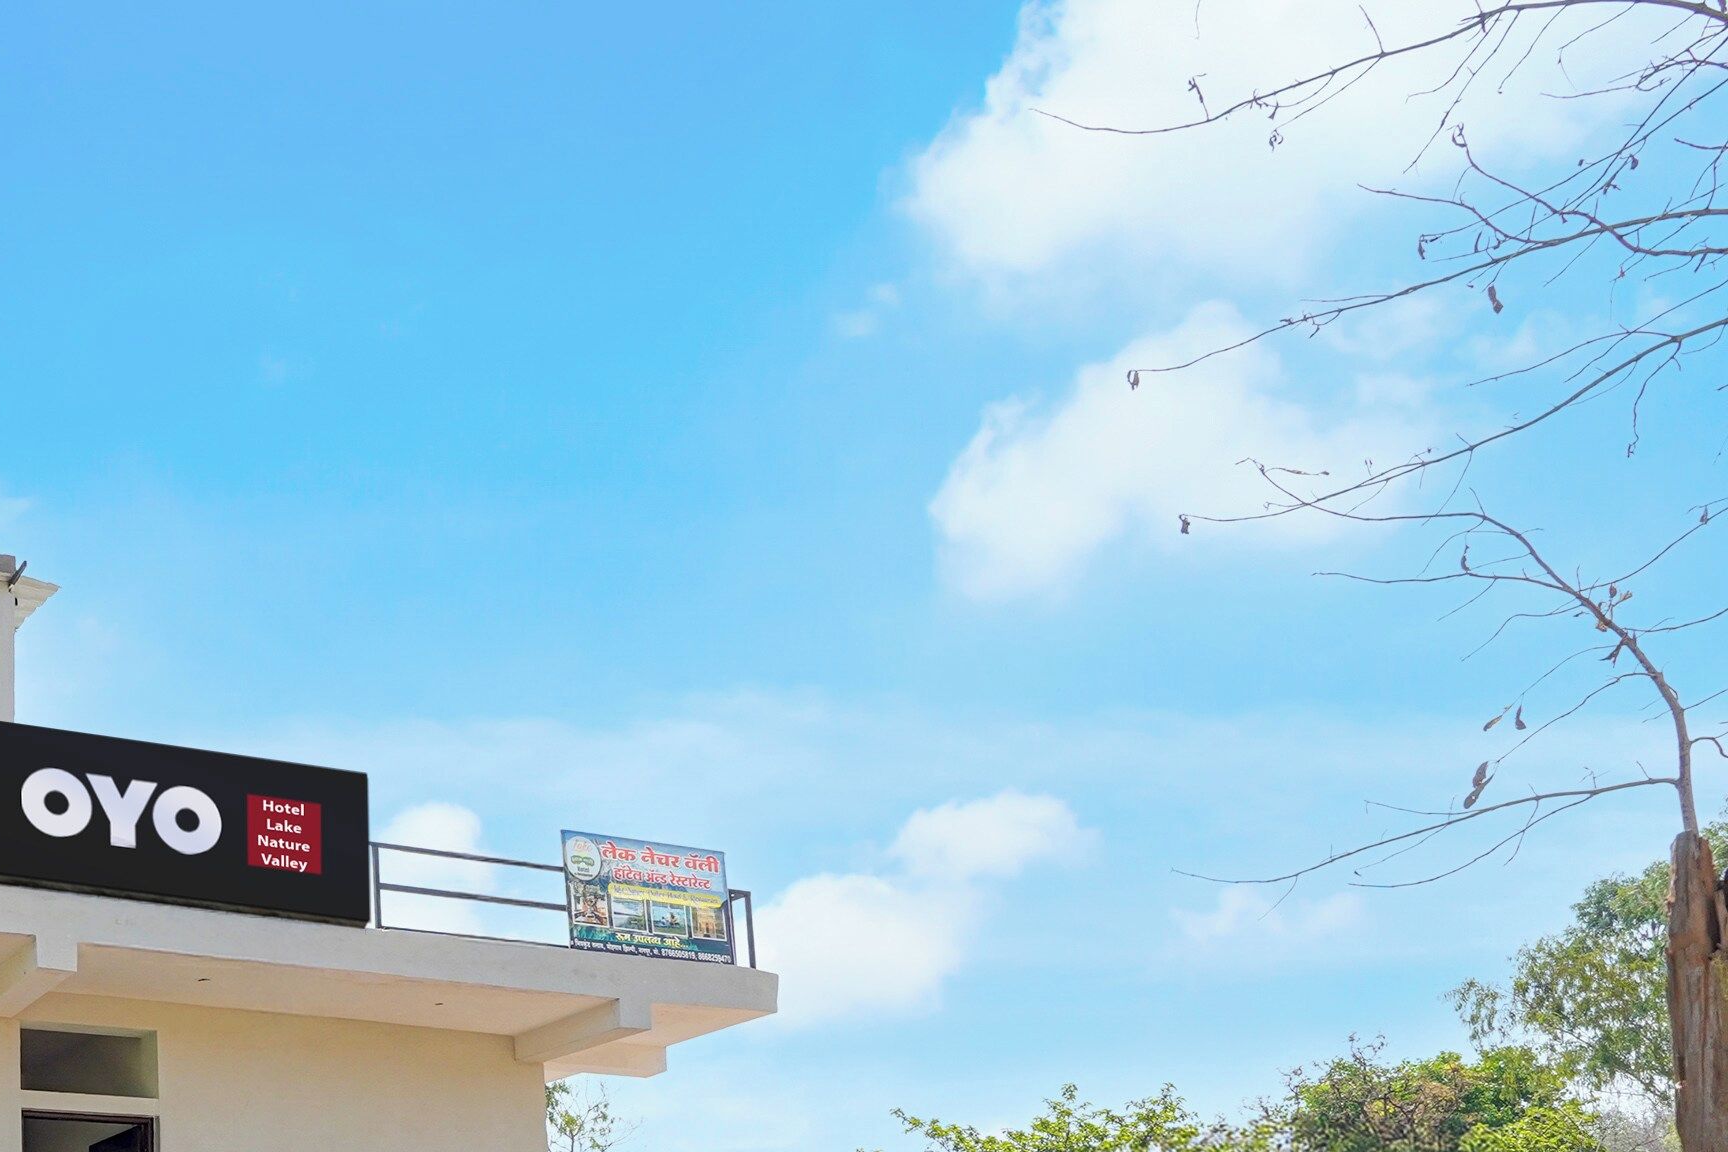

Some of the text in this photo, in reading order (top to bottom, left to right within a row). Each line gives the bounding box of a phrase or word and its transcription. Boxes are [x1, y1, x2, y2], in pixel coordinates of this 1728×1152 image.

[21, 767, 223, 855] OYO
[262, 799, 305, 816] Hotel
[266, 818, 302, 834] Lake
[257, 834, 311, 852] Nature
[260, 853, 308, 872] Valley
[601, 841, 636, 860] लेक
[641, 846, 680, 867] नेचर
